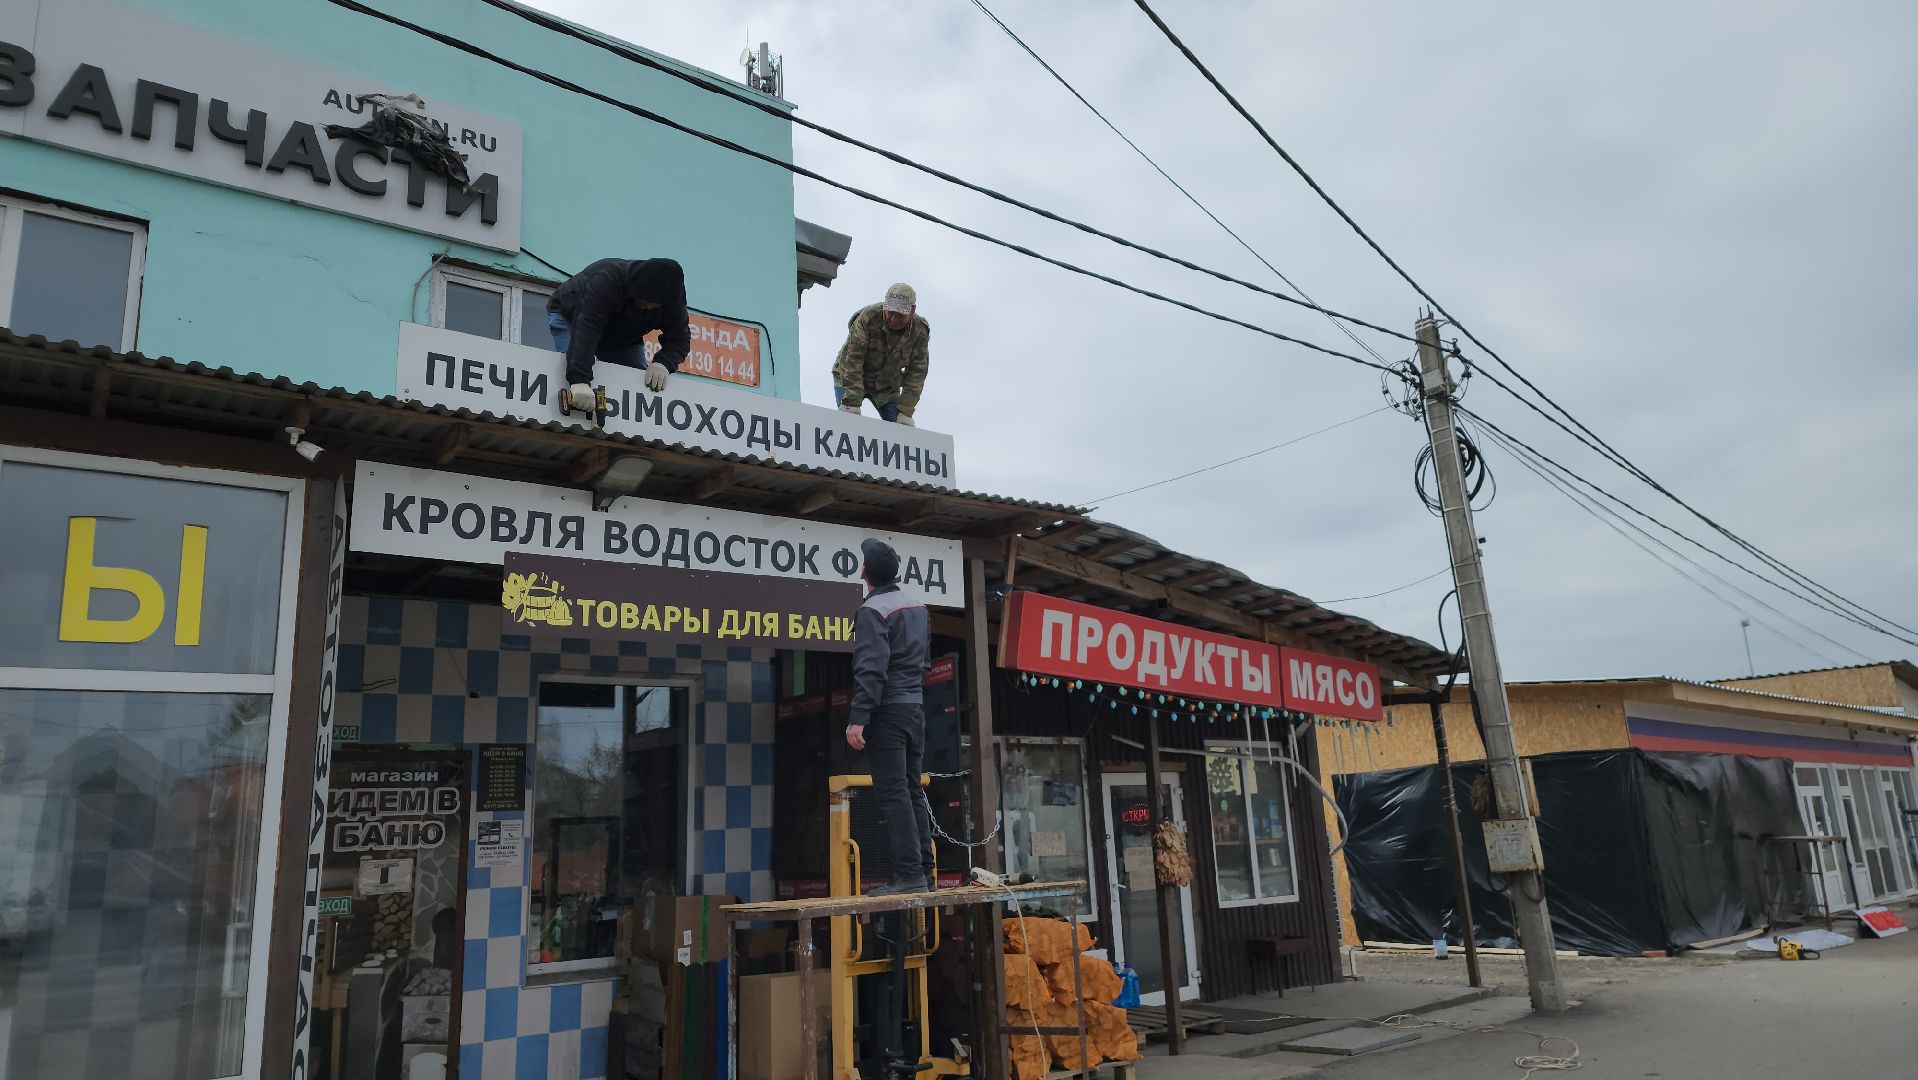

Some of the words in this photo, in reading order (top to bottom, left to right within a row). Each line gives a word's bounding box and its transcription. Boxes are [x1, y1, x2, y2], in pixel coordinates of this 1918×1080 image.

[718, 356, 735, 377] 14
[738, 361, 756, 382] 44
[425, 351, 548, 406] ПЕЧИ
[602, 389, 801, 452] ЫМОХОДЫ
[814, 427, 948, 479] КАМИНЫ
[382, 492, 585, 551] КРОВЛЯ
[603, 519, 821, 576] ВОДОСТОК
[831, 547, 947, 595] ФАД
[58, 515, 208, 647] Ы
[576, 598, 710, 635] ТОВАРЫ
[716, 608, 780, 640] ДЛЯ
[1040, 608, 1272, 694] ПРОДУКТЫ
[1289, 658, 1375, 710] МЯСО
[332, 726, 357, 739] ХОД
[351, 770, 439, 783] магазин
[327, 787, 429, 821] ИДЕМ
[433, 787, 461, 815] В
[333, 820, 446, 852] БАНЮ
